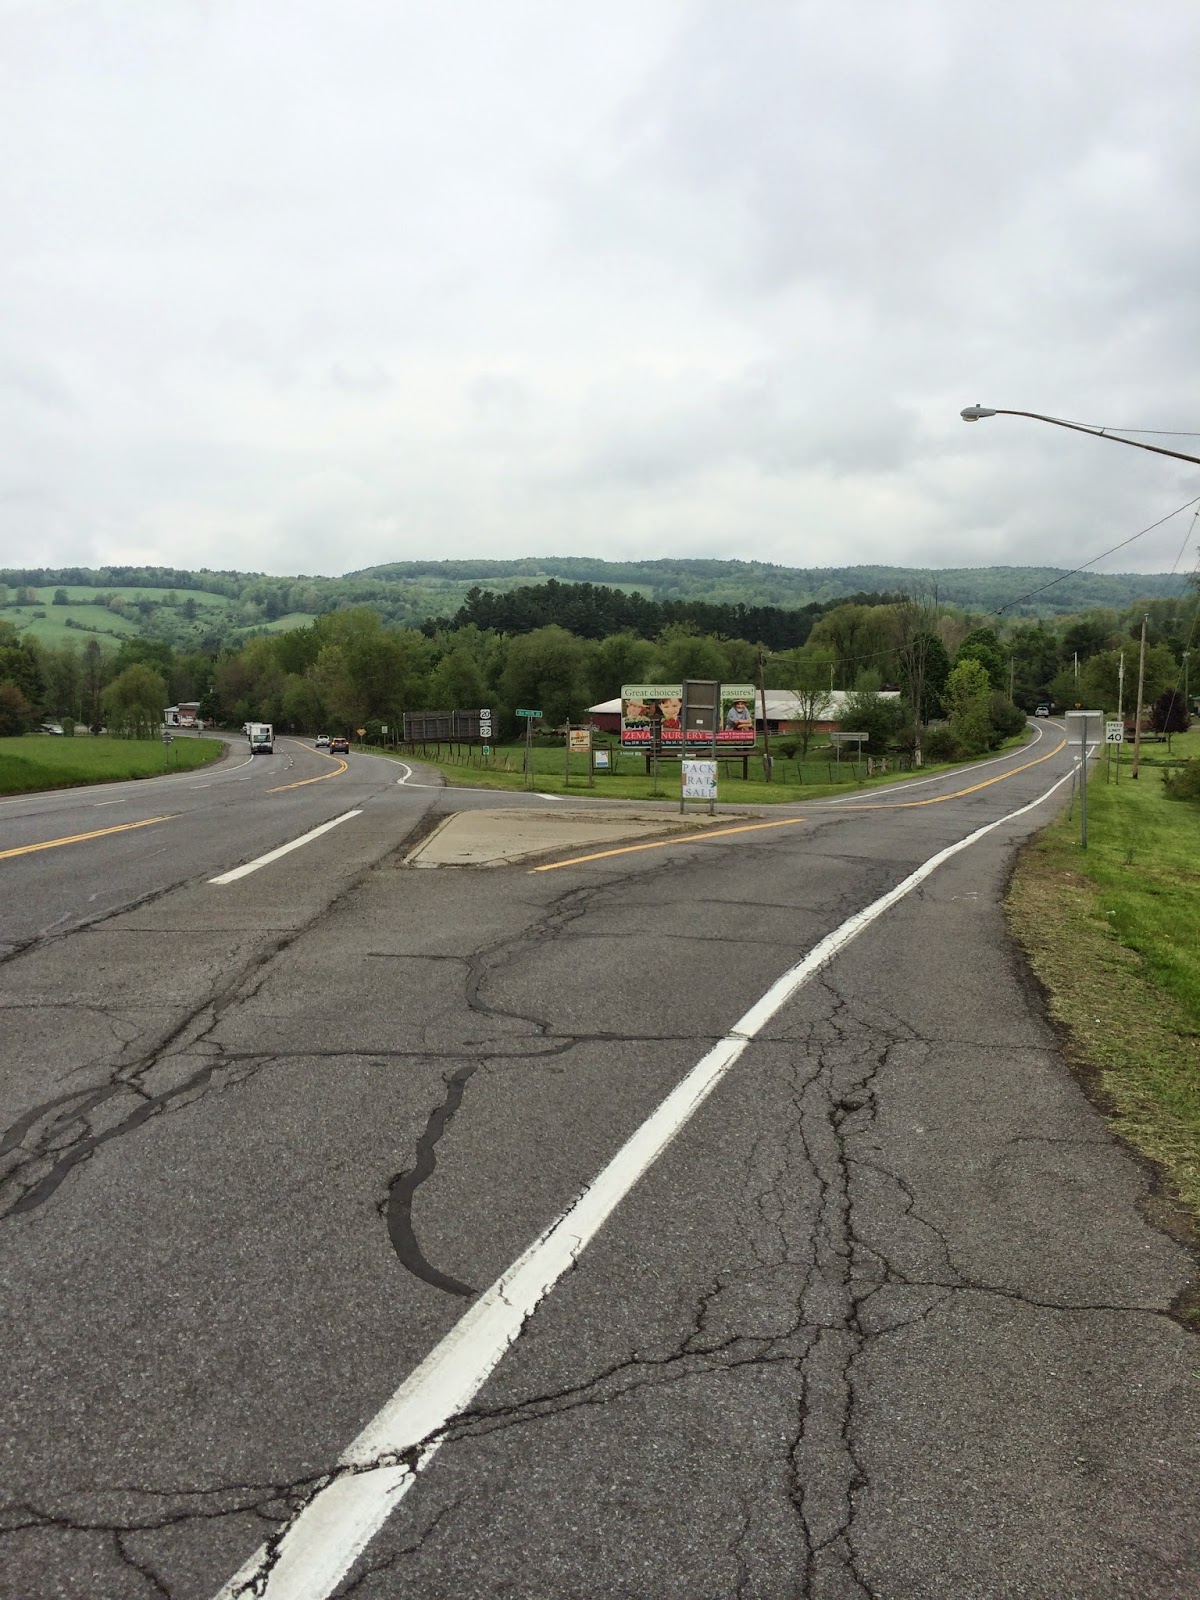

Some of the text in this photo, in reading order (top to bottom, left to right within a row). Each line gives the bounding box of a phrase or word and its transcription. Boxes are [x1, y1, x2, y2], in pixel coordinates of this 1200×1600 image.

[624, 688, 754, 697] Great choices! easures!
[624, 731, 651, 739] ZEMA
[683, 763, 715, 773] PACK
[687, 776, 711, 785] RAT
[685, 788, 715, 798] SALE
